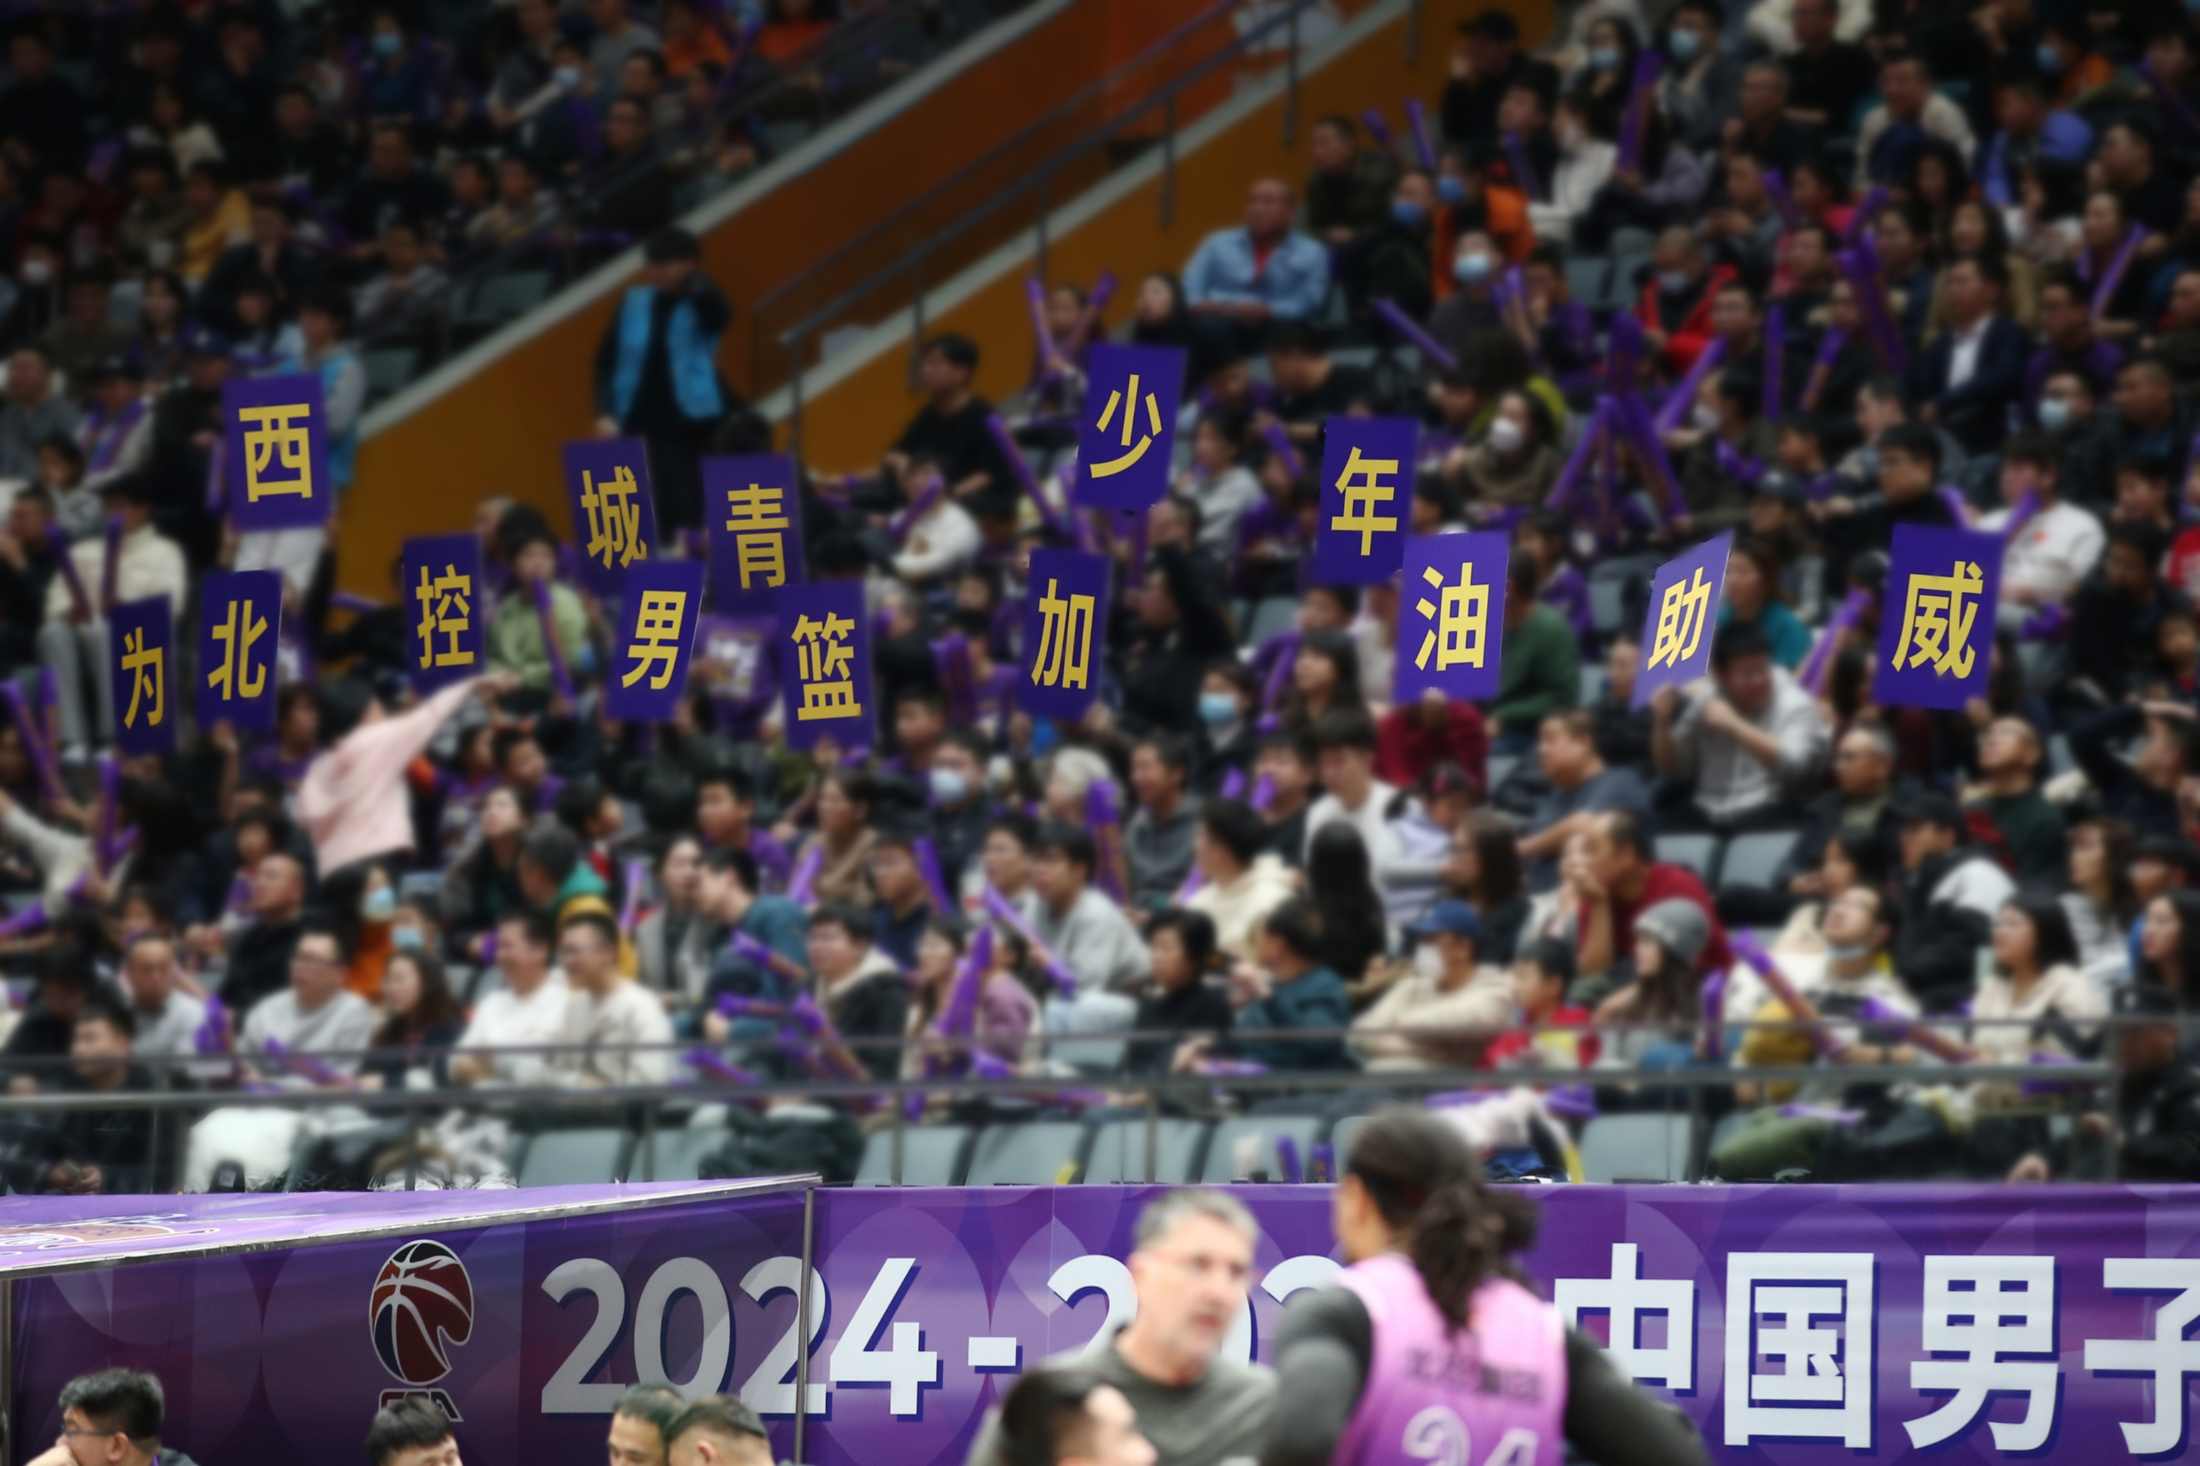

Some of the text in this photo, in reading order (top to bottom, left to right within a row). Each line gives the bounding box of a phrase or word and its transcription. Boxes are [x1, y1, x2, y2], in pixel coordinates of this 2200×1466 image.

[239, 403, 313, 503] 西
[1090, 374, 1163, 479] 少
[580, 466, 648, 569] 城
[726, 483, 790, 589] 青
[1331, 447, 1399, 556] 年
[208, 599, 268, 701] 北
[415, 564, 476, 669] 控
[621, 590, 687, 690] 男
[791, 612, 862, 721] 篮
[1031, 578, 1096, 690] 加
[1415, 562, 1490, 671] 油
[1648, 567, 1712, 670] 助
[1892, 560, 1984, 679] 威
[121, 626, 164, 729] 为
[1555, 1243, 2200, 1453] 中国男子
